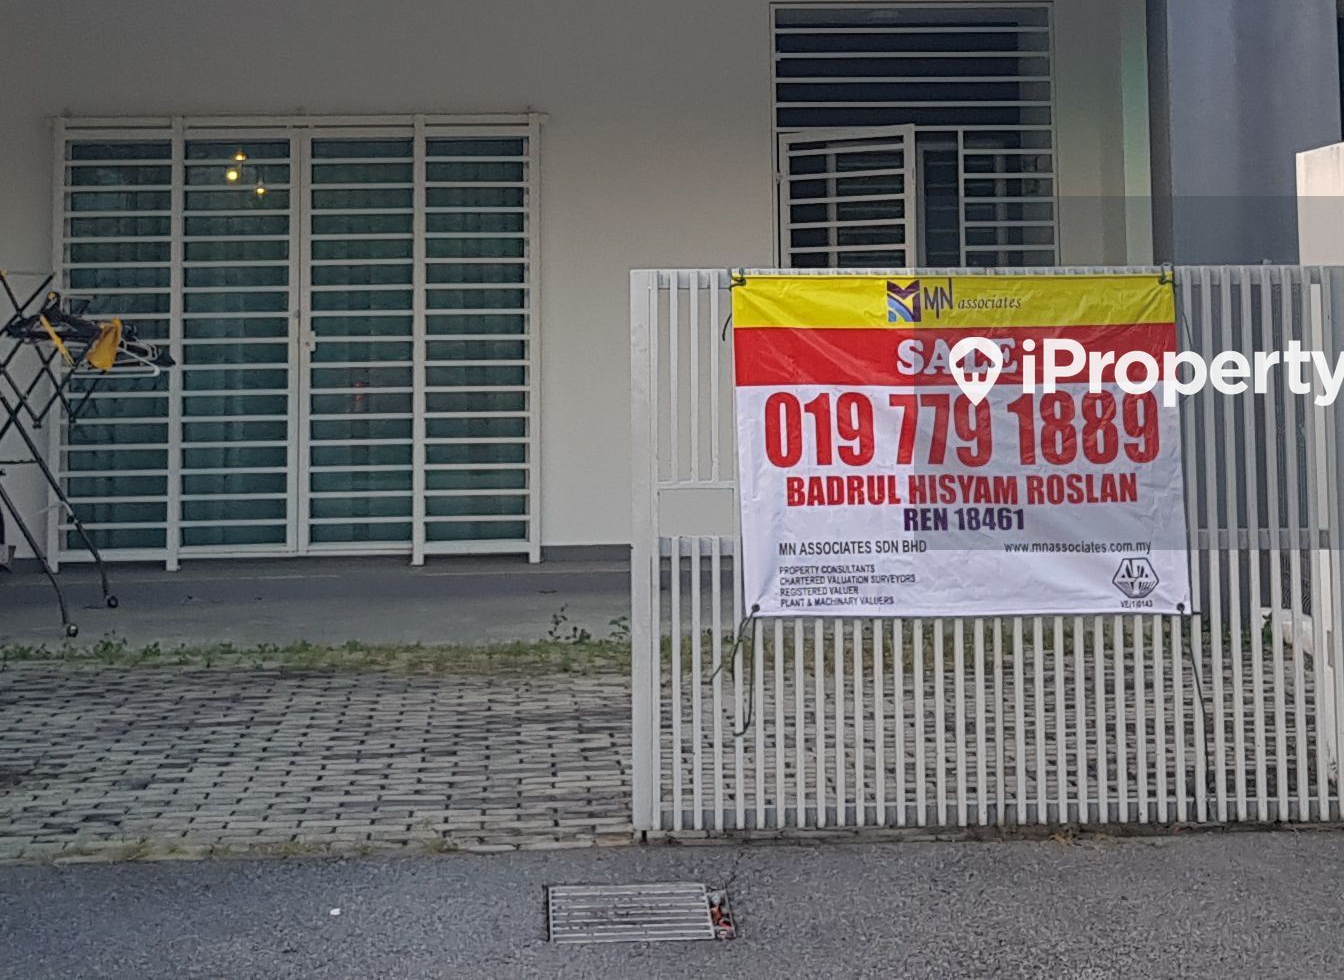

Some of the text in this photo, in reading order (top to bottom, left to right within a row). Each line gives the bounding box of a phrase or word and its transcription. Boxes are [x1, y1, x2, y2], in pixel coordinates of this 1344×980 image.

[924, 277, 1022, 319] MN associates
[764, 389, 1160, 468] 019 779 1889
[786, 472, 1138, 507] BADRUL HISYAM ROSLAN
[903, 507, 1025, 532] REN 18461
[779, 540, 927, 556] MN ASSOCIATES SDN BHD
[1004, 540, 1152, 555] www.mnassociates.com.my
[779, 564, 875, 575] PROPERTY CONSULTANTS
[780, 574, 916, 586] CHARTERED VALUATION SURVEYORS
[780, 585, 859, 597] REGISTERED VALUER
[780, 597, 805, 608] PLANT
[806, 597, 813, 607] &
[859, 595, 895, 605] VALUERS
